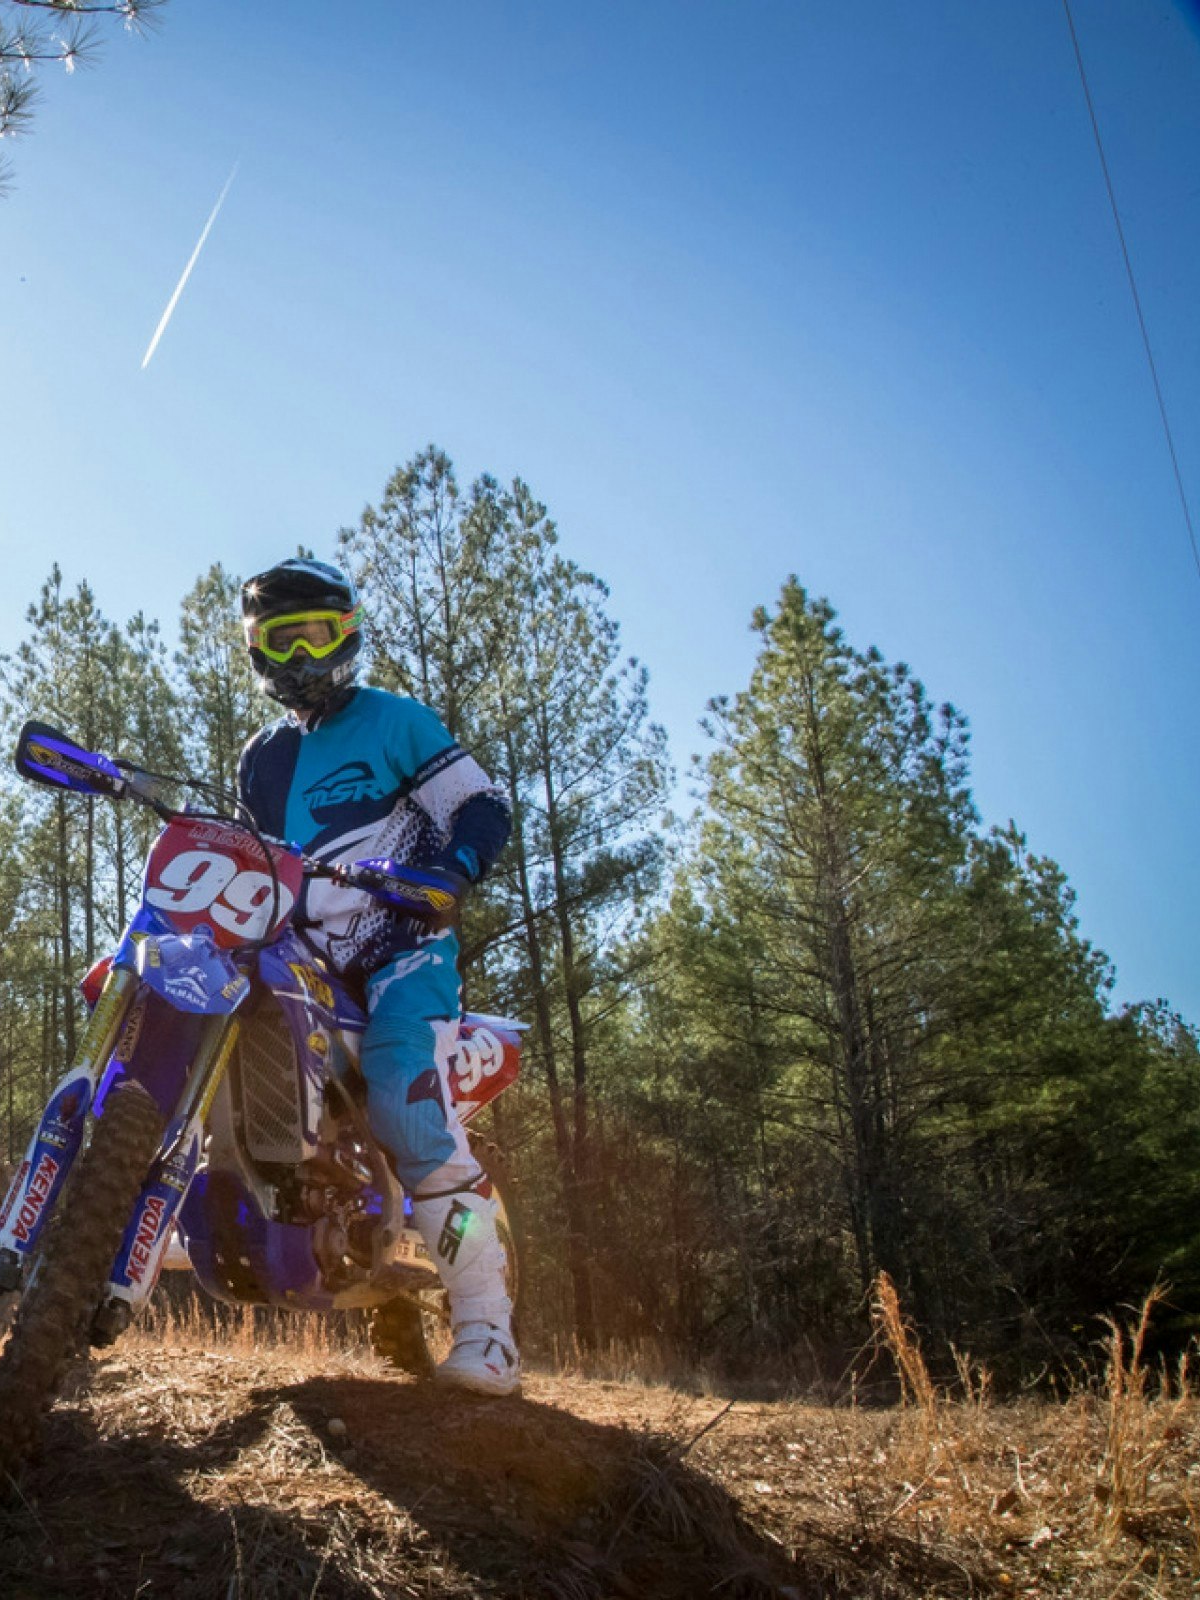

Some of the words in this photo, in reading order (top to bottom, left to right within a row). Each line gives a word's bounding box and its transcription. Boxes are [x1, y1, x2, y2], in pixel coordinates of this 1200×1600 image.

[146, 851, 294, 940] 99
[455, 1027, 504, 1093] 99
[10, 1152, 60, 1244] KENDA
[124, 1195, 168, 1285] KENDA
